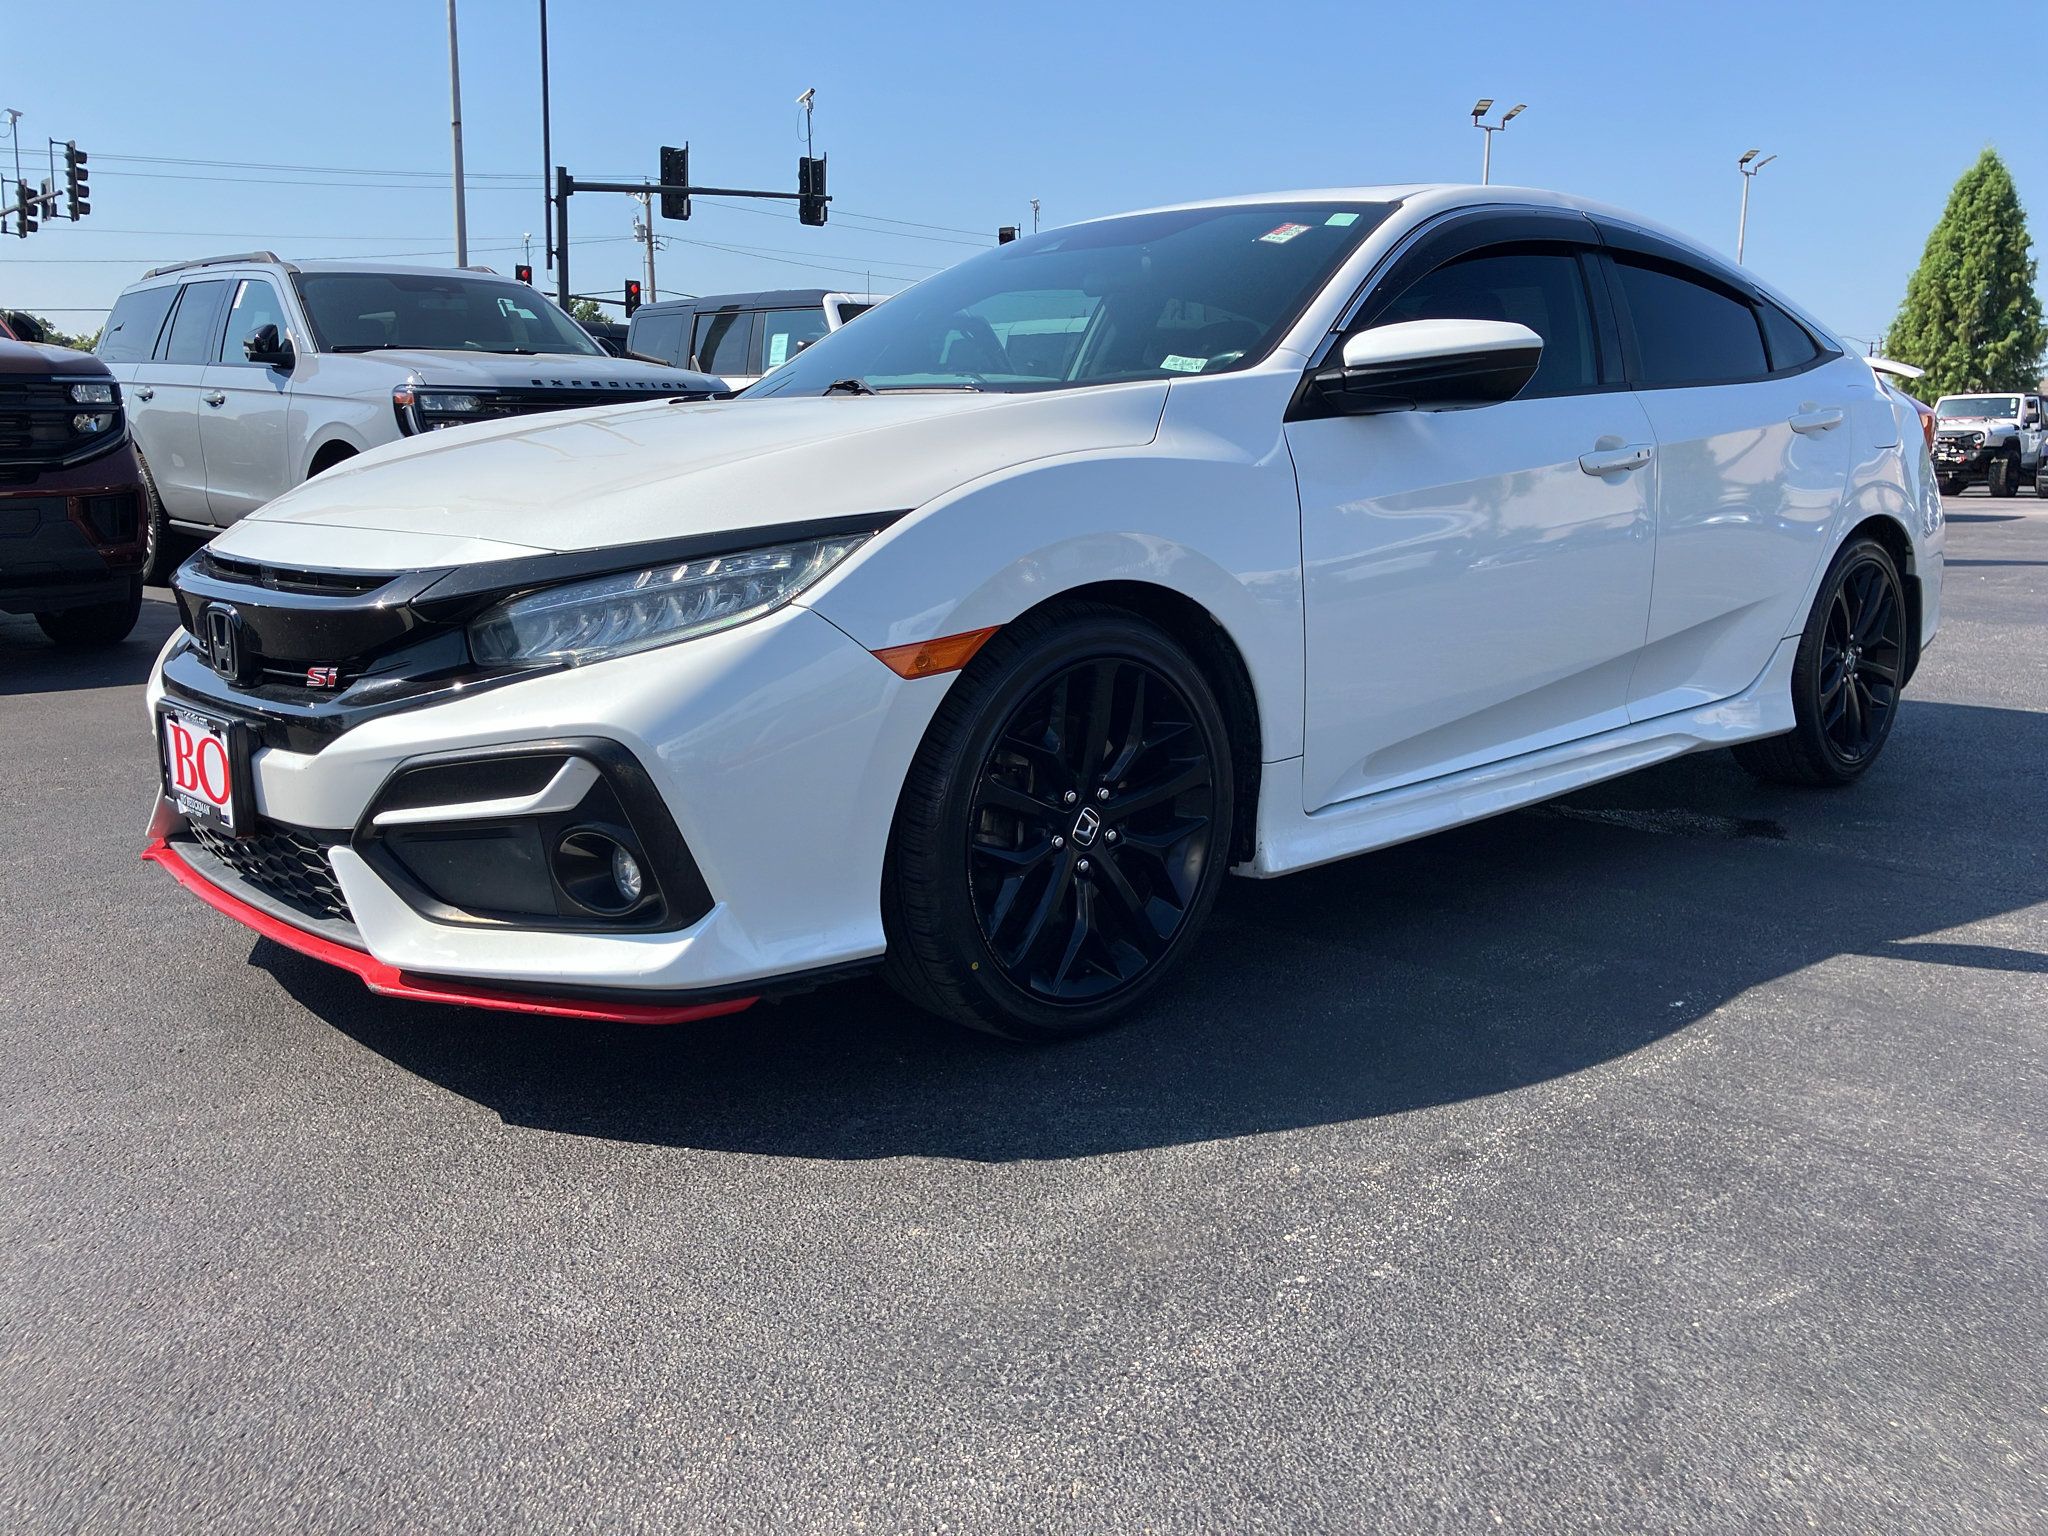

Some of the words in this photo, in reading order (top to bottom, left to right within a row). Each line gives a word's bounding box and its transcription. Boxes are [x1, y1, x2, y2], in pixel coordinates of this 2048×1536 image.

[532, 379, 688, 389] EXPEDITION
[306, 666, 339, 689] Si
[171, 724, 231, 805] BO
